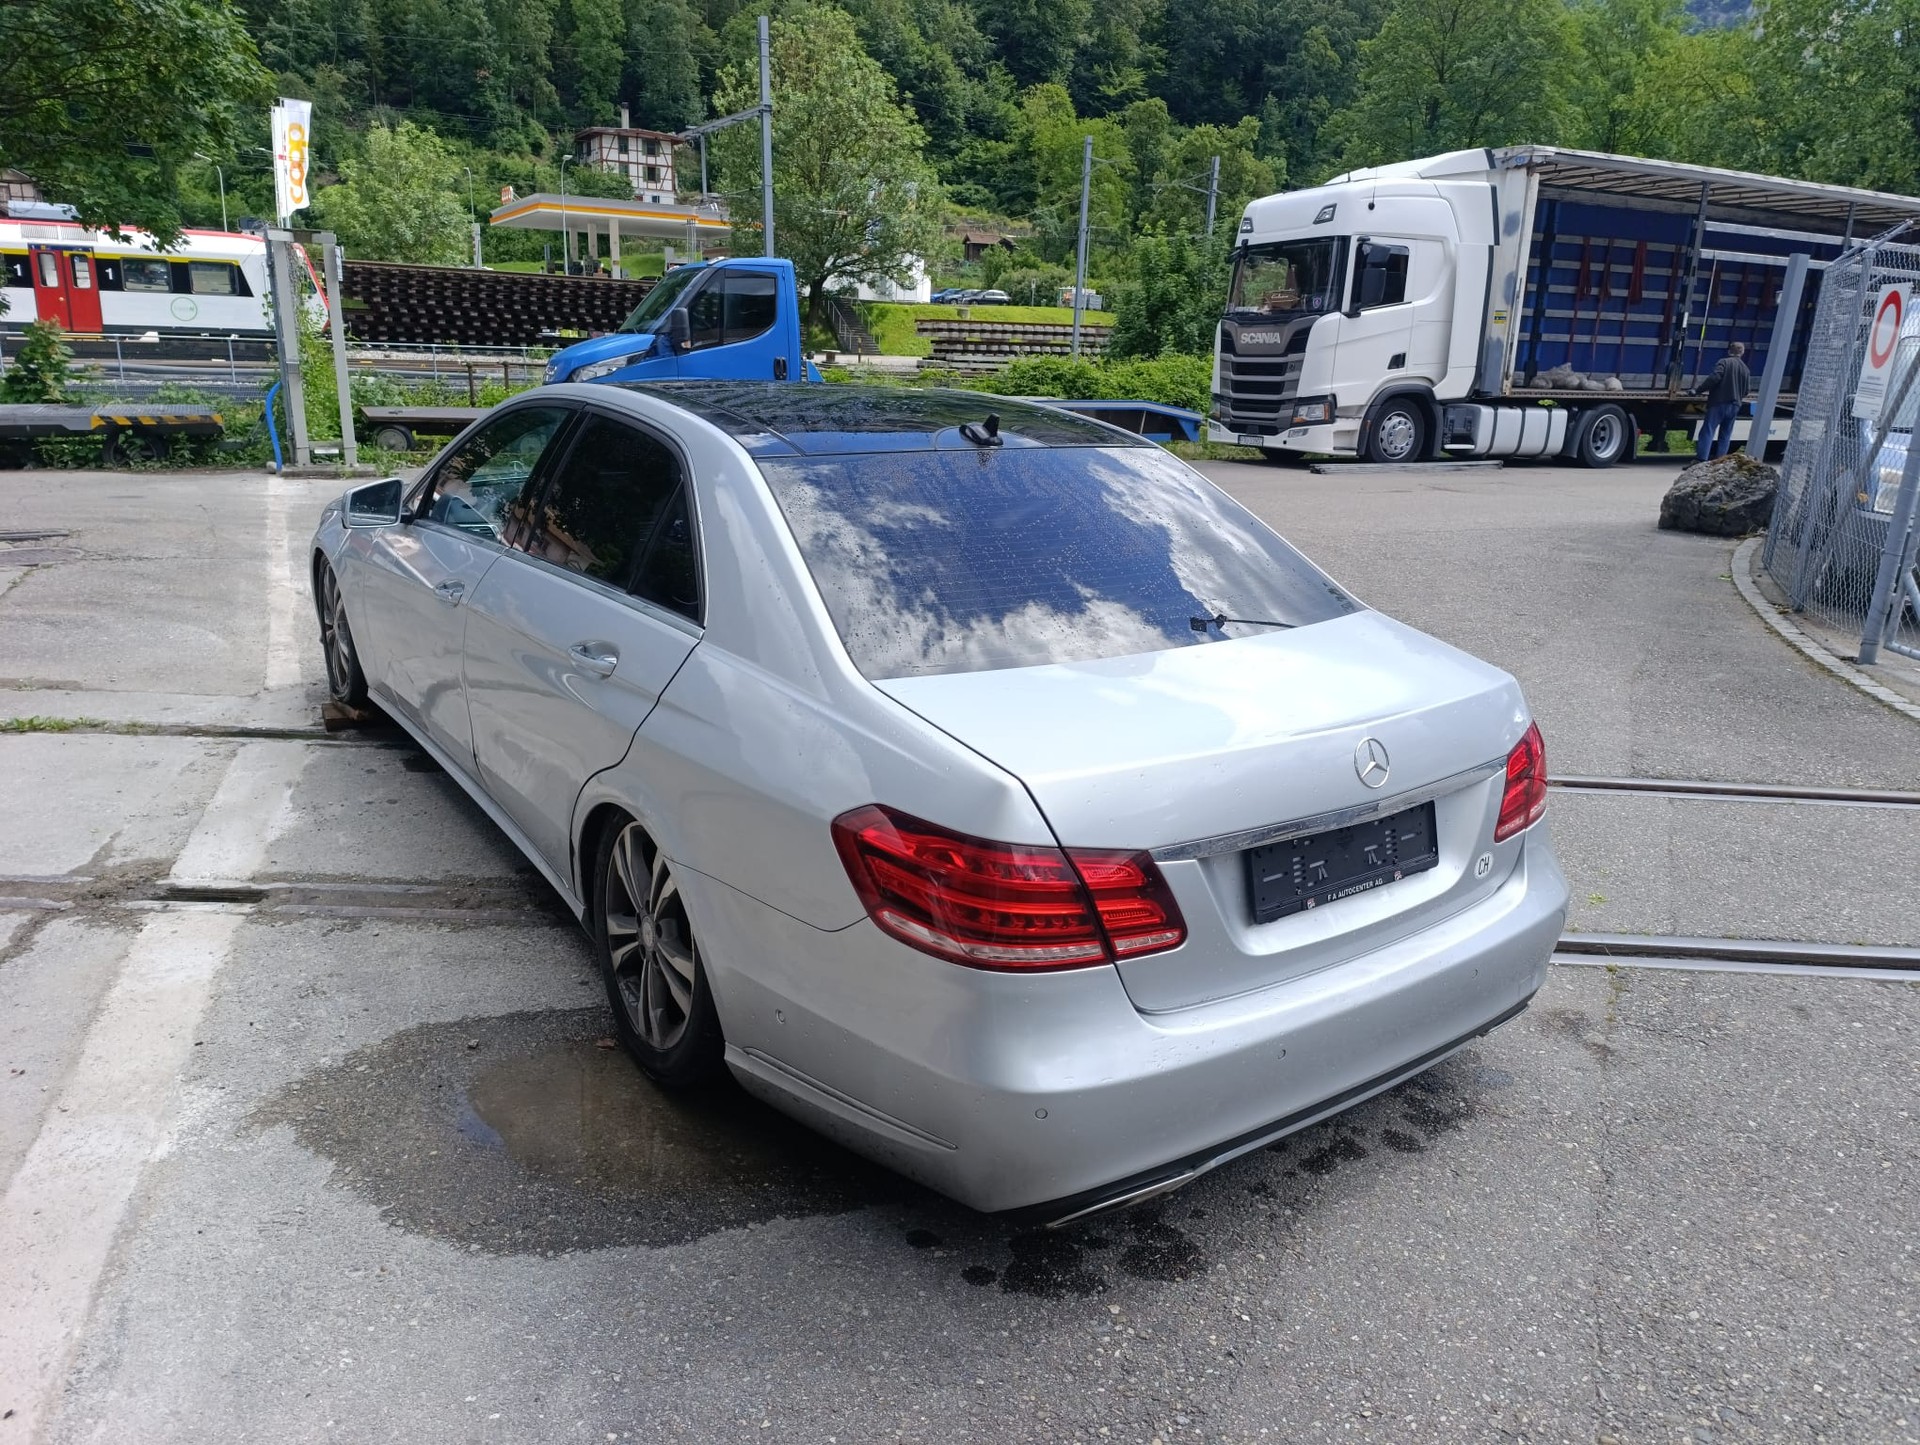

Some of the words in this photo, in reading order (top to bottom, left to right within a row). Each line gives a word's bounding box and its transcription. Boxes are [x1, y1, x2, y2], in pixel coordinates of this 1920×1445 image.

[288, 122, 308, 204] coop
[13, 264, 22, 276] 1
[105, 267, 113, 280] 1
[1240, 332, 1280, 344] SCANIA
[1478, 855, 1490, 876] CH
[1338, 880, 1374, 898] AUTOCENTER
[1374, 878, 1383, 886] AG
